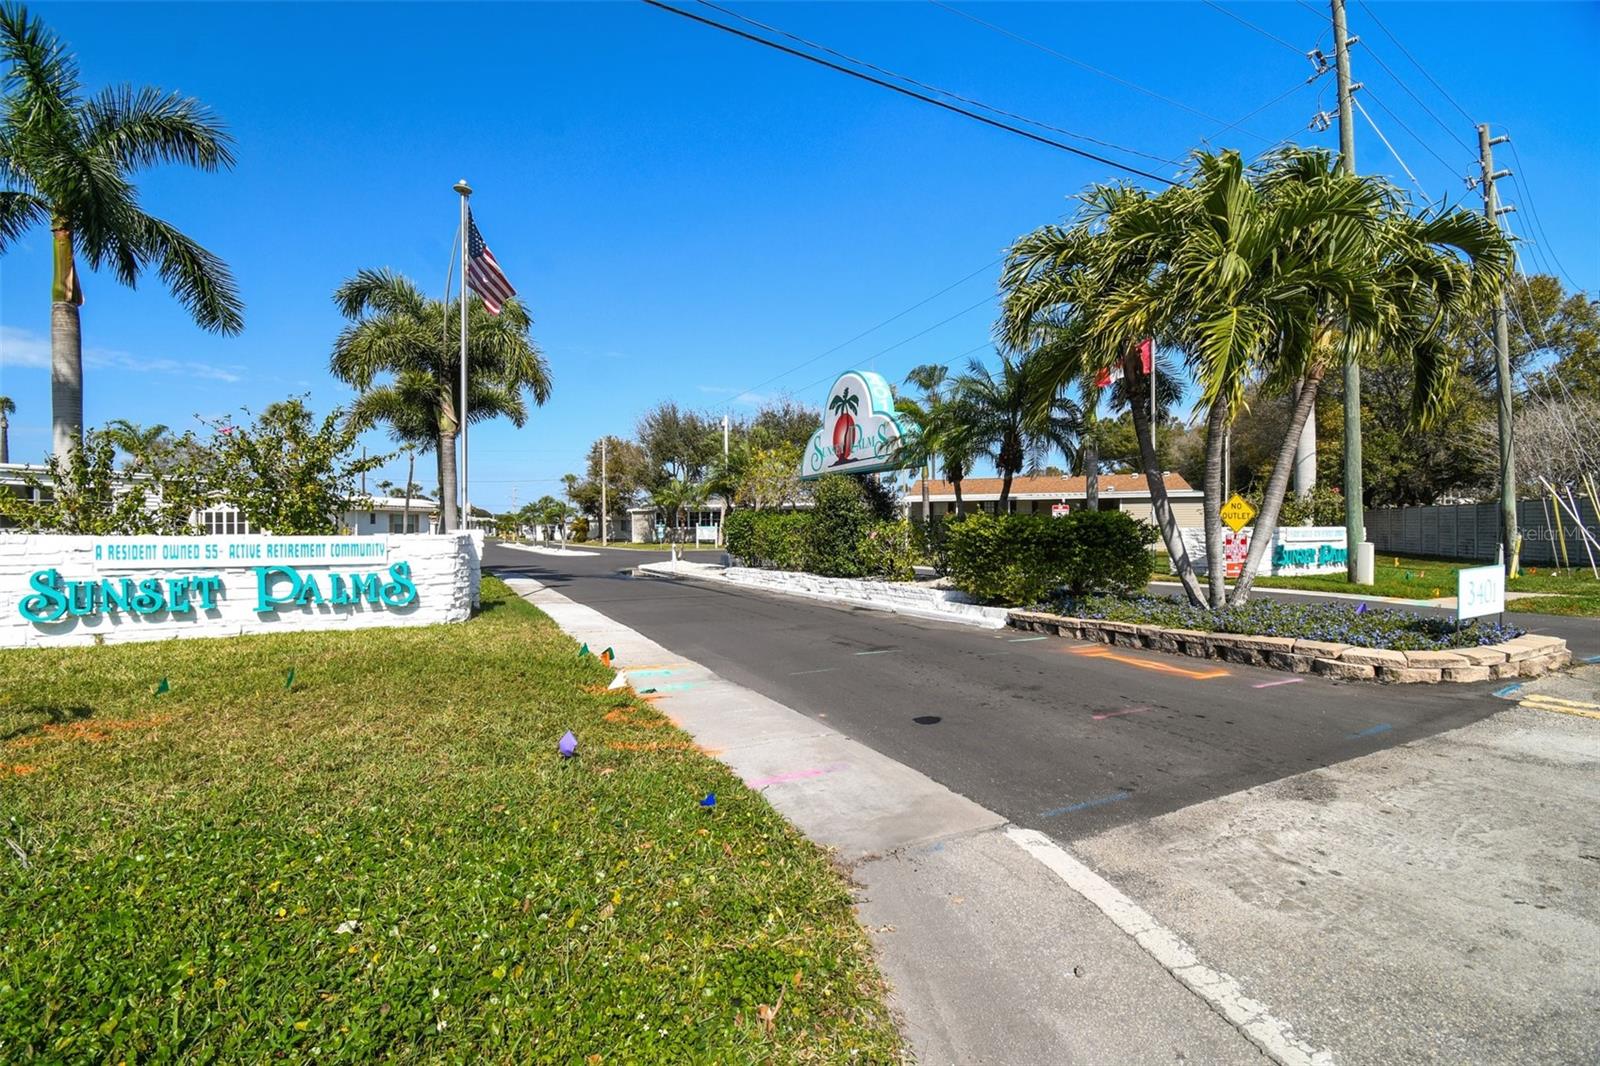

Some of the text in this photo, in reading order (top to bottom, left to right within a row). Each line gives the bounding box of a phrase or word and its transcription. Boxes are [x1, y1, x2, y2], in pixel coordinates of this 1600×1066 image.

[1222, 512, 1250, 520] OUTLET
[95, 544, 102, 560] A
[108, 544, 157, 560] RESIDENT
[163, 544, 200, 560] OWNED
[229, 543, 261, 558] ACTIVE
[267, 543, 326, 558] RETIREMENT
[330, 542, 385, 557] COMMUNITY
[18, 561, 417, 623] SUNSET PALMS
